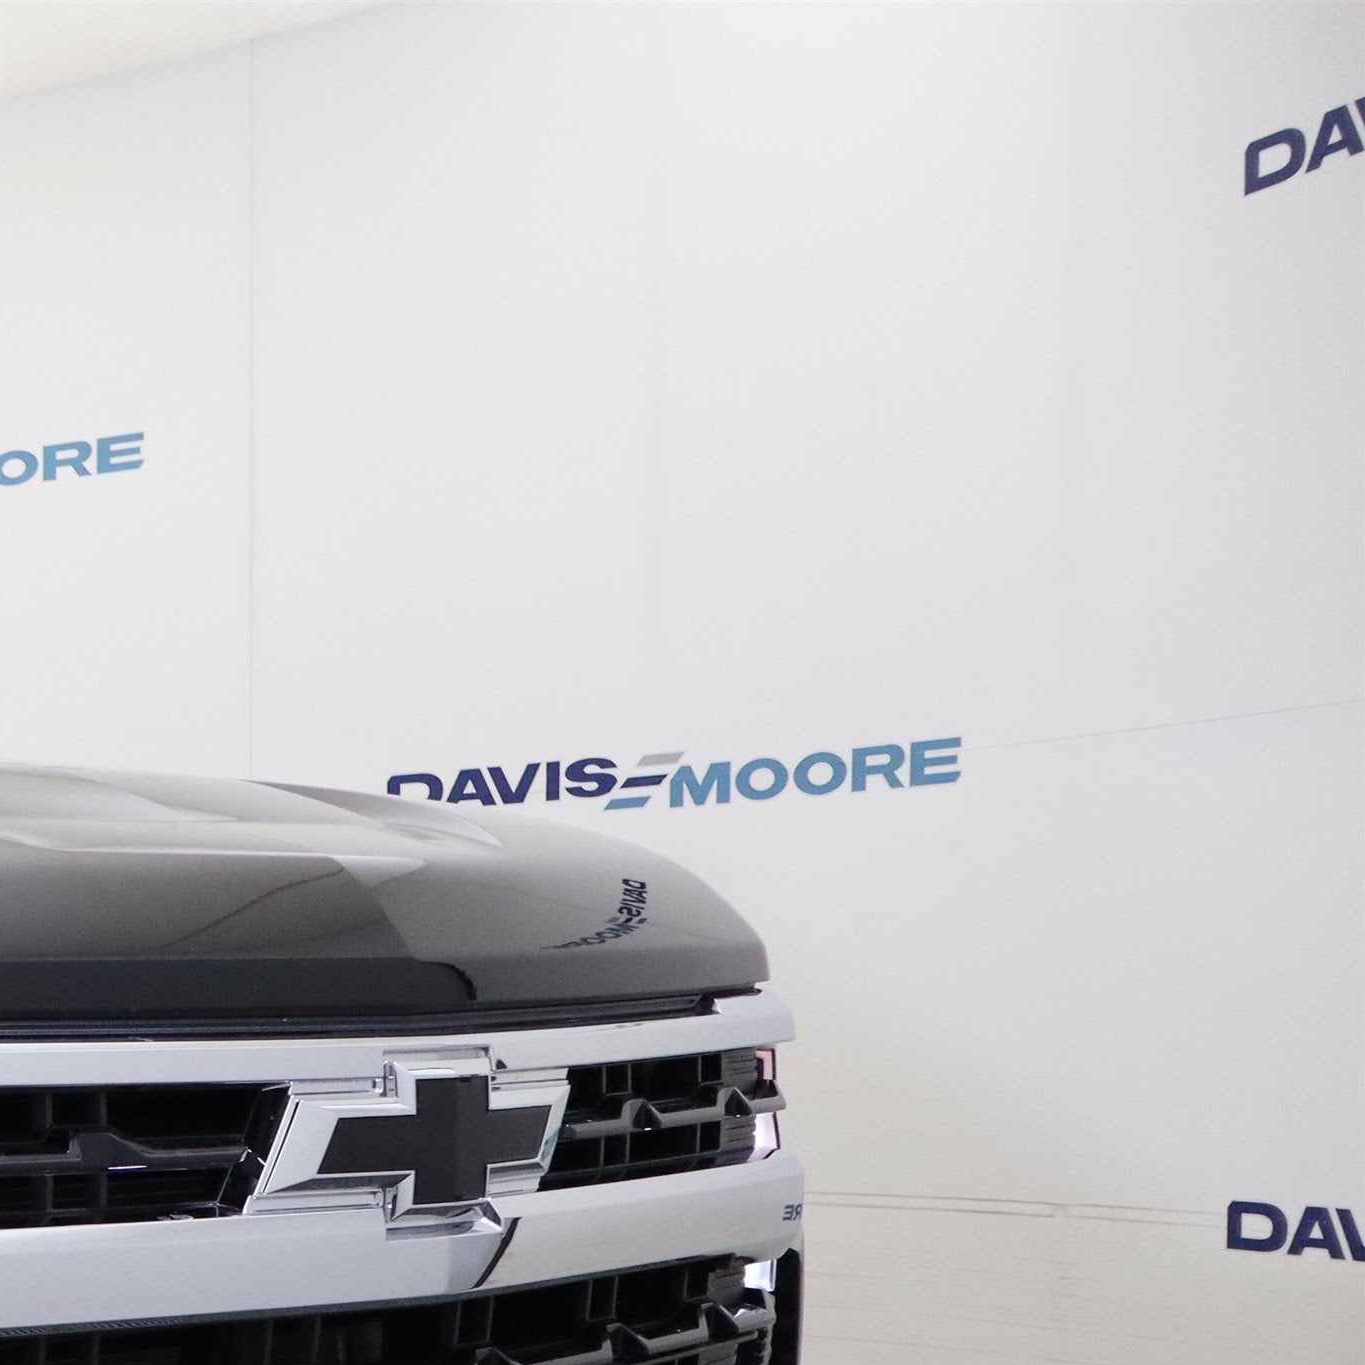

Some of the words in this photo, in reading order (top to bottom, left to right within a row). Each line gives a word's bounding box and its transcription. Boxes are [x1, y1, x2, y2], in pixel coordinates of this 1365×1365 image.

[1244, 96, 1365, 196] DA
[387, 757, 617, 806] DAVIS
[669, 736, 962, 808] MOORE
